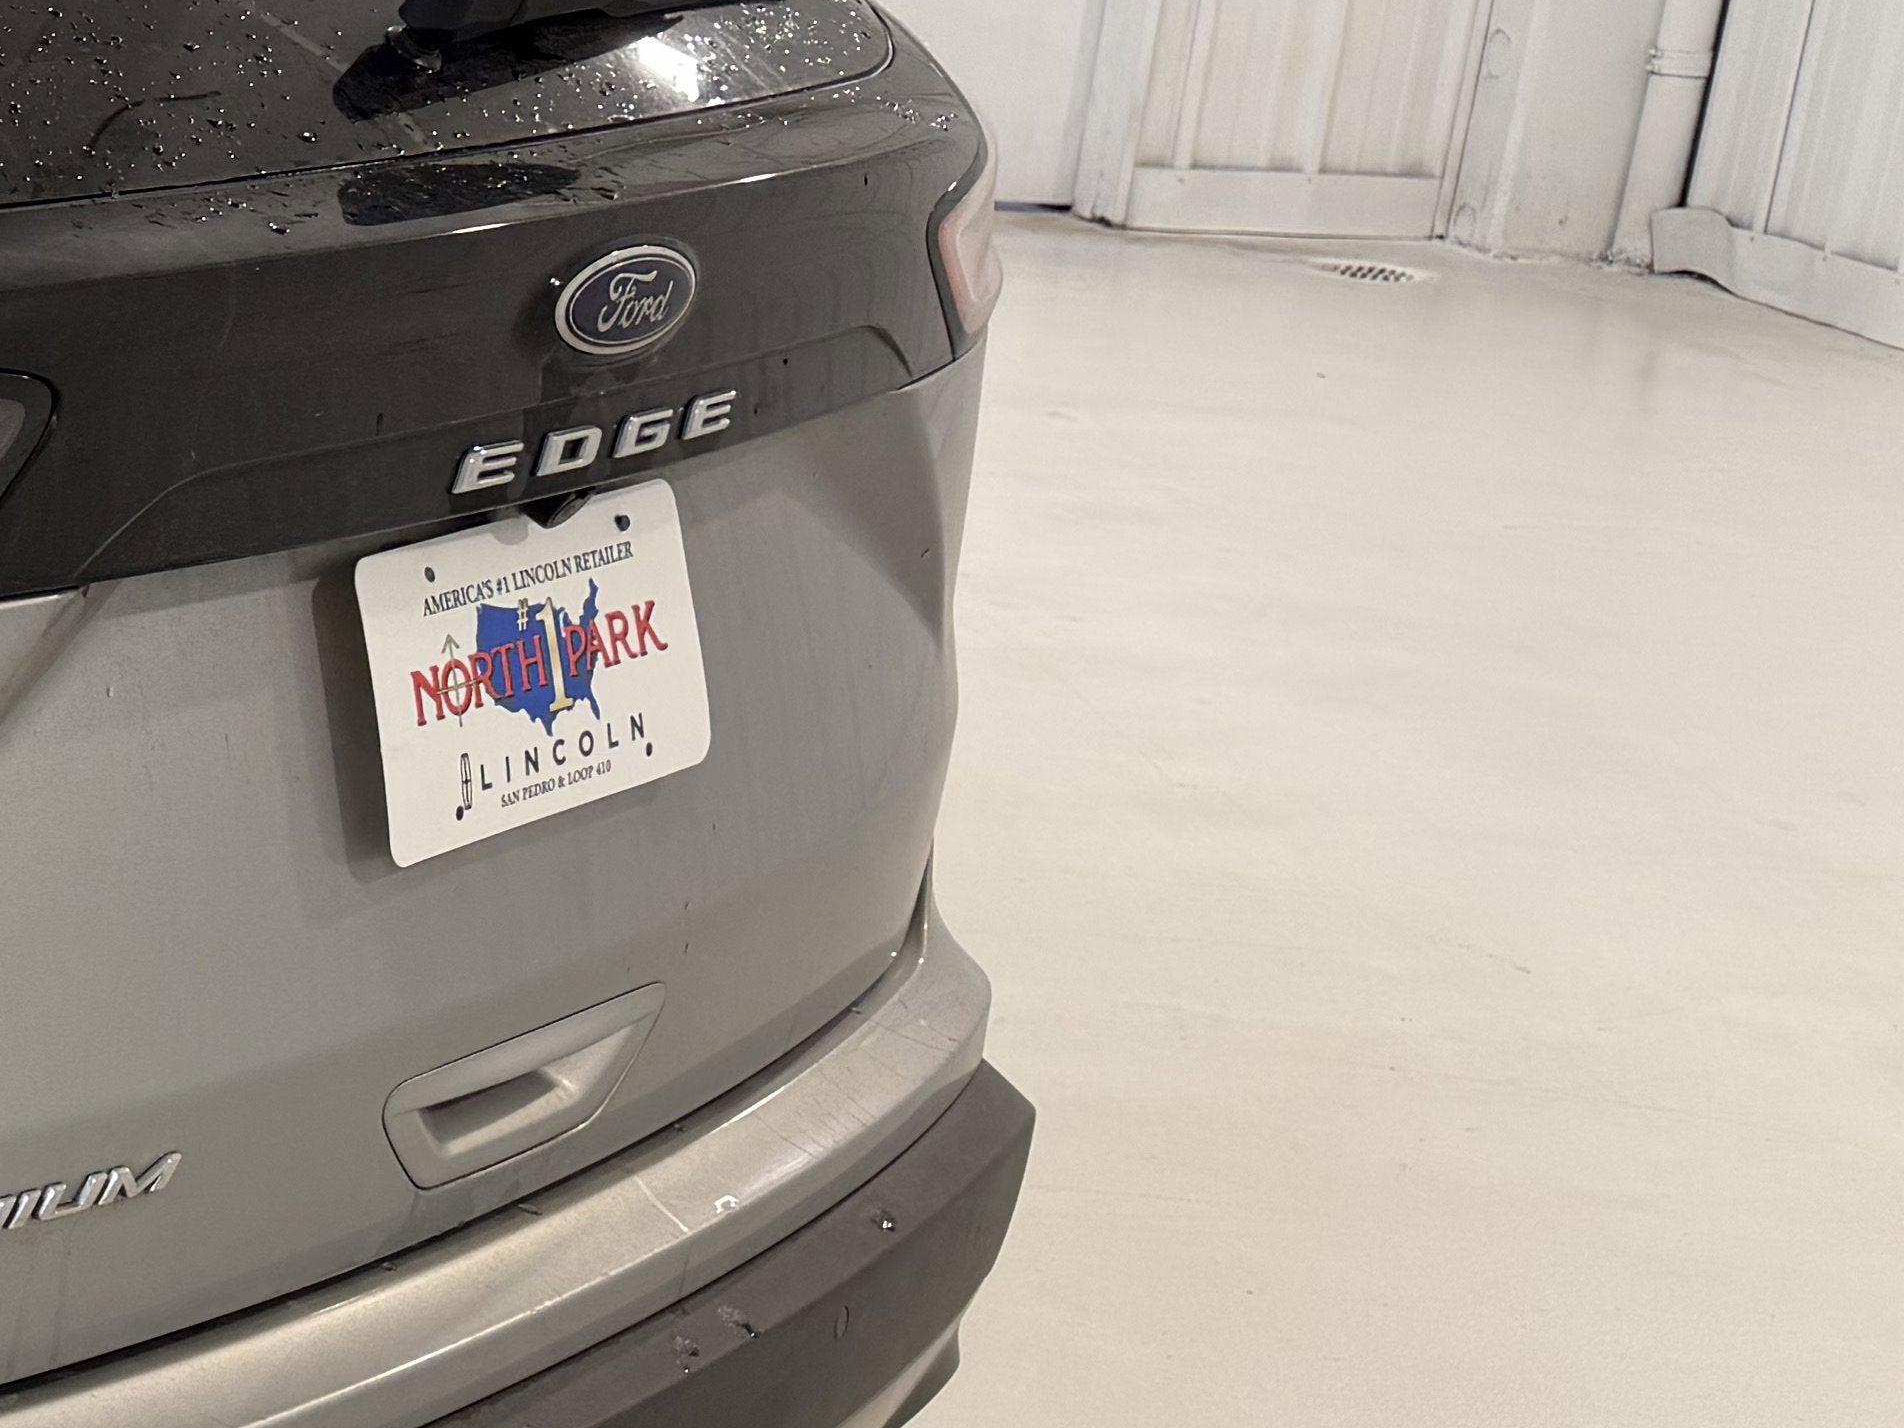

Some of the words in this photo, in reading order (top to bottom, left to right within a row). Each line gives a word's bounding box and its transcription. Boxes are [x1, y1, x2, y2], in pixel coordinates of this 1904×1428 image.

[597, 270, 673, 333] Ford
[451, 389, 737, 495] EDGE
[423, 578, 494, 617] AMERICA'S
[496, 576, 511, 595] #1
[511, 556, 573, 591] LINCOLN
[573, 540, 634, 573] RETAILER
[410, 635, 548, 727] NORTH
[562, 599, 669, 677] PARK
[480, 712, 646, 791] LINCOLN
[500, 787, 522, 808] SAN
[522, 776, 555, 800] PEDRO
[557, 774, 566, 788] &
[566, 765, 594, 786] LOOP
[595, 758, 612, 778] 410
